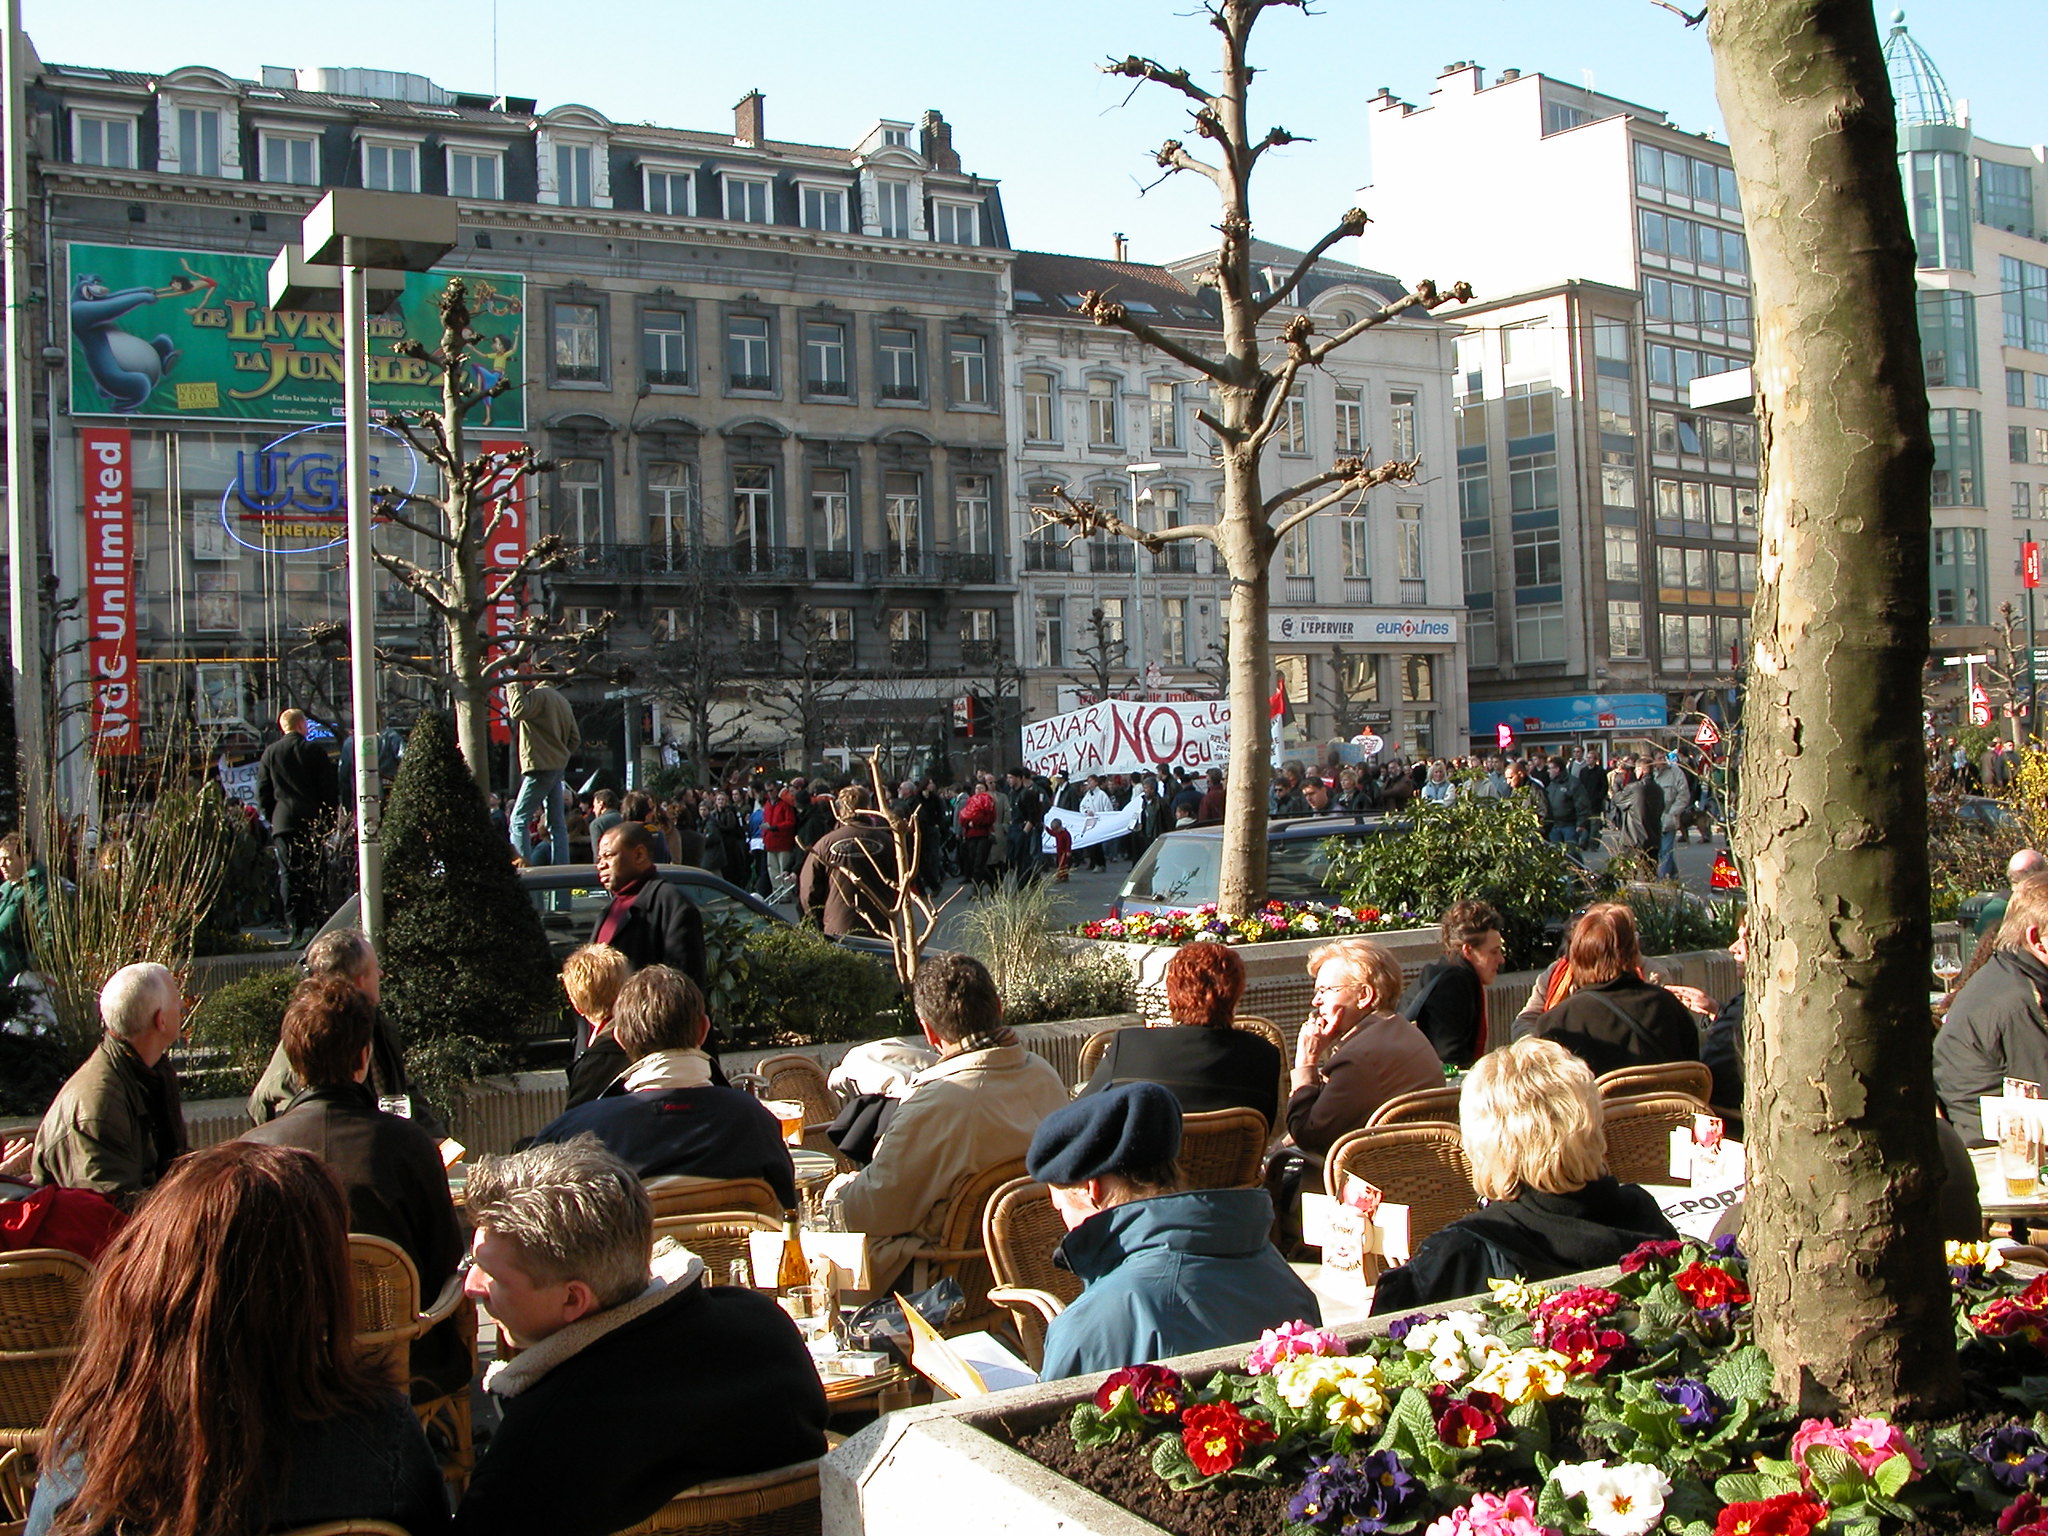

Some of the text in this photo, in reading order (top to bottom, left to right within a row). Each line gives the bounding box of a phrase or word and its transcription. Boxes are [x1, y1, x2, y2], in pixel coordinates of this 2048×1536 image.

[192, 308, 228, 328] LE
[225, 299, 345, 351] LIVR
[233, 351, 269, 371] LA
[91, 441, 127, 640] Unlimited
[263, 523, 341, 538] CINEMAS
[1301, 621, 1354, 634] L'EPERVIER
[1600, 718, 1615, 726] TUI
[1024, 707, 1102, 754] AZNAR
[1109, 703, 1182, 766] NO
